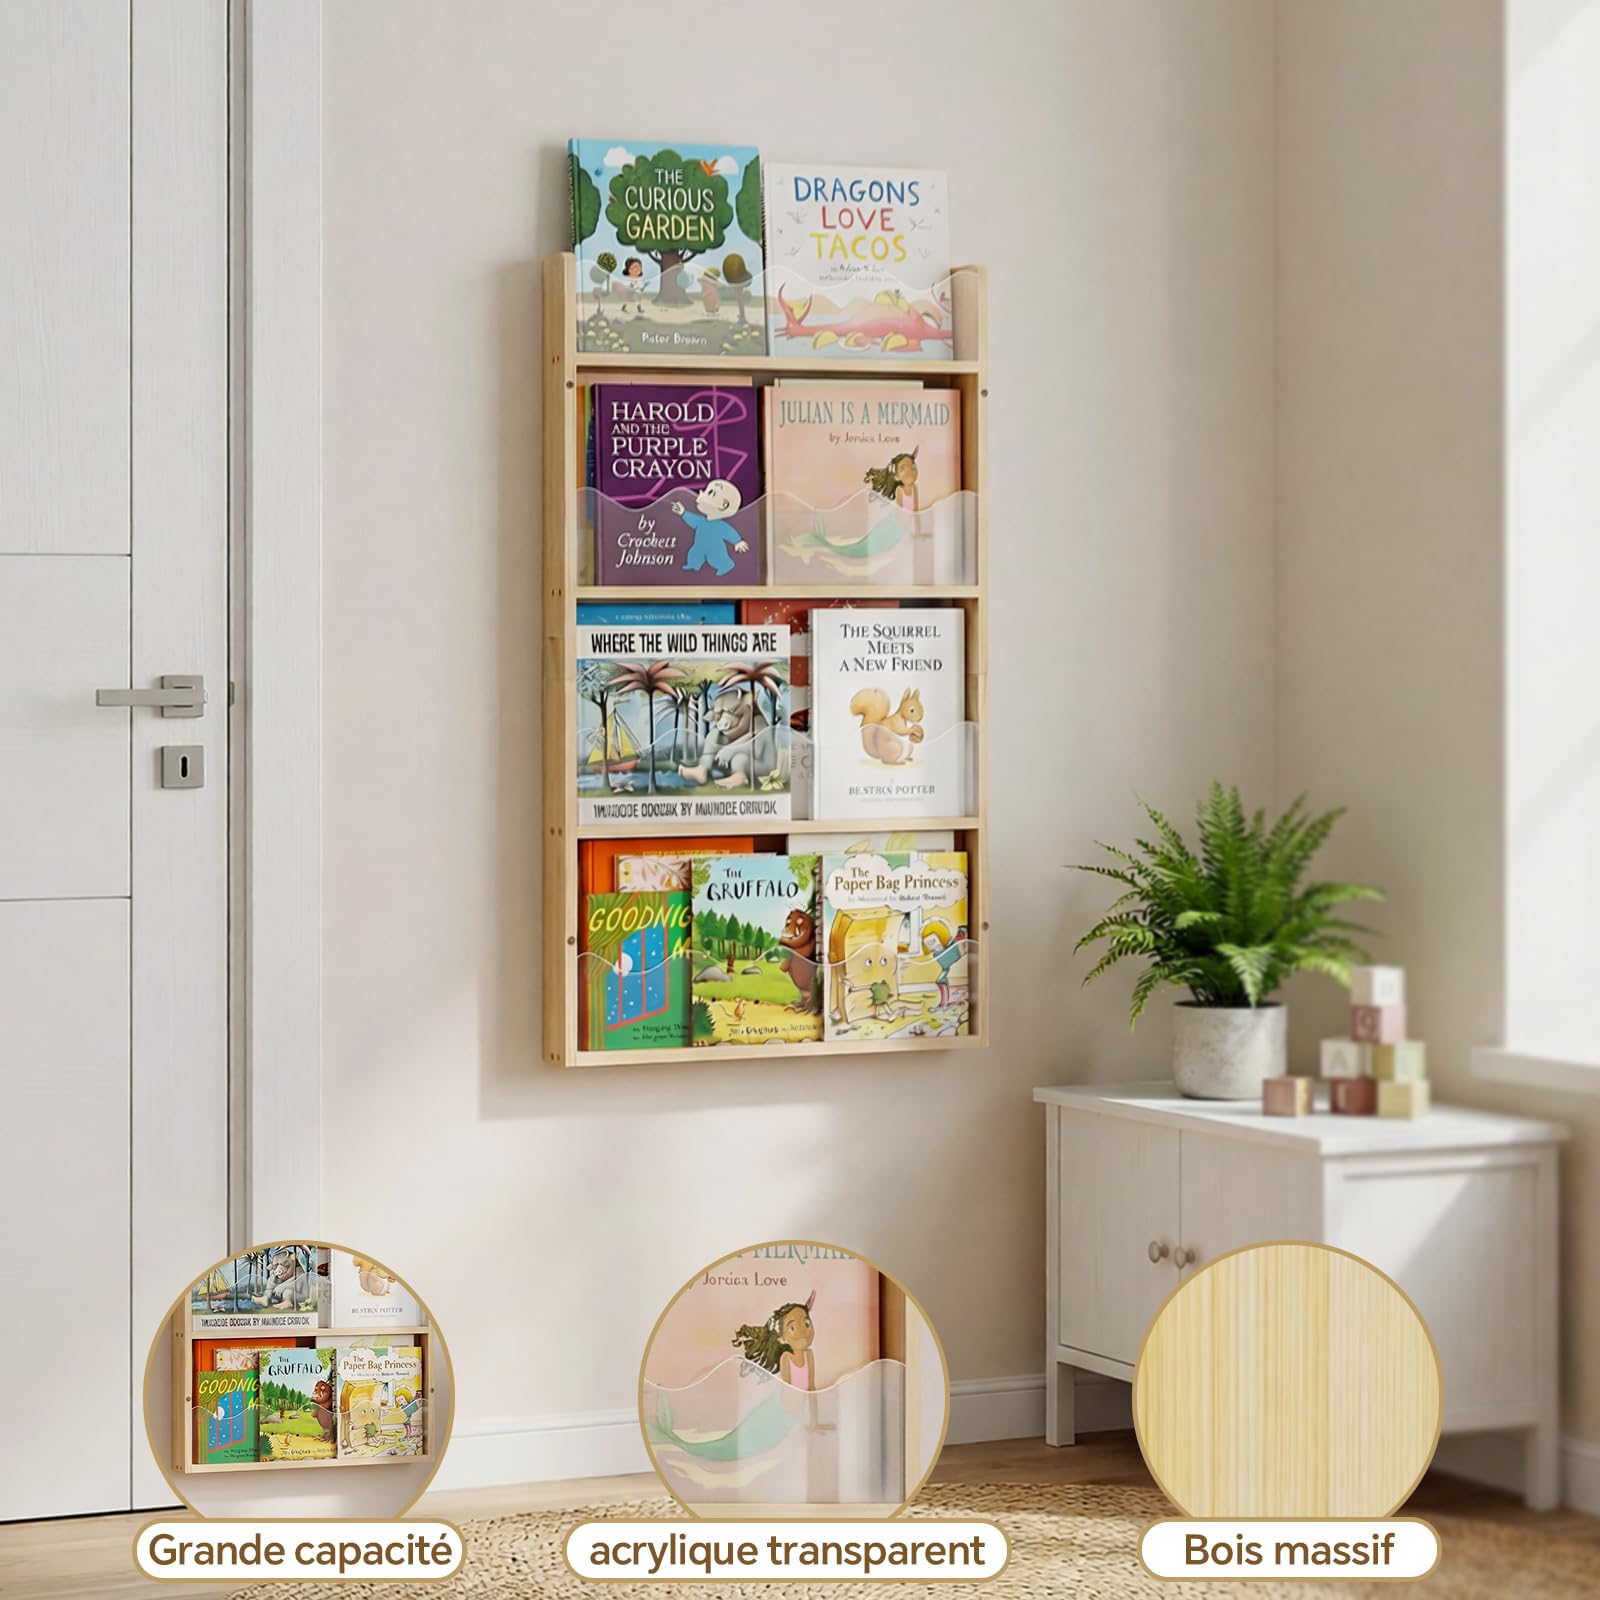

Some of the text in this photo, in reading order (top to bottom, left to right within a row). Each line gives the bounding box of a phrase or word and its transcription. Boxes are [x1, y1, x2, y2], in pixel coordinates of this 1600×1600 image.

[654, 168, 683, 185] THE
[625, 186, 715, 213] CURIOUS
[793, 176, 920, 206] DRAGONS
[626, 213, 715, 241] GARDEN
[822, 206, 895, 232] LOVE
[809, 232, 908, 263] TACOS
[612, 401, 714, 422] HAROLD
[779, 400, 950, 429] JULIAN IS A MERMAID
[612, 423, 670, 435] AND THE
[878, 431, 900, 443] Love
[612, 436, 708, 457] PURPLE
[612, 458, 713, 479] CRAYON
[638, 514, 656, 534] by
[591, 632, 777, 654] WHERE THE WILD THINGS ARE
[839, 659, 850, 672] A
[851, 867, 869, 878] The
[707, 880, 799, 901] GRUFFALO
[835, 874, 960, 895] Paper Bag Princess
[755, 1271, 787, 1286] Love
[268, 1363, 323, 1376] GRUFFALO
[343, 1361, 366, 1372] Paper
[368, 1360, 382, 1371] Bag
